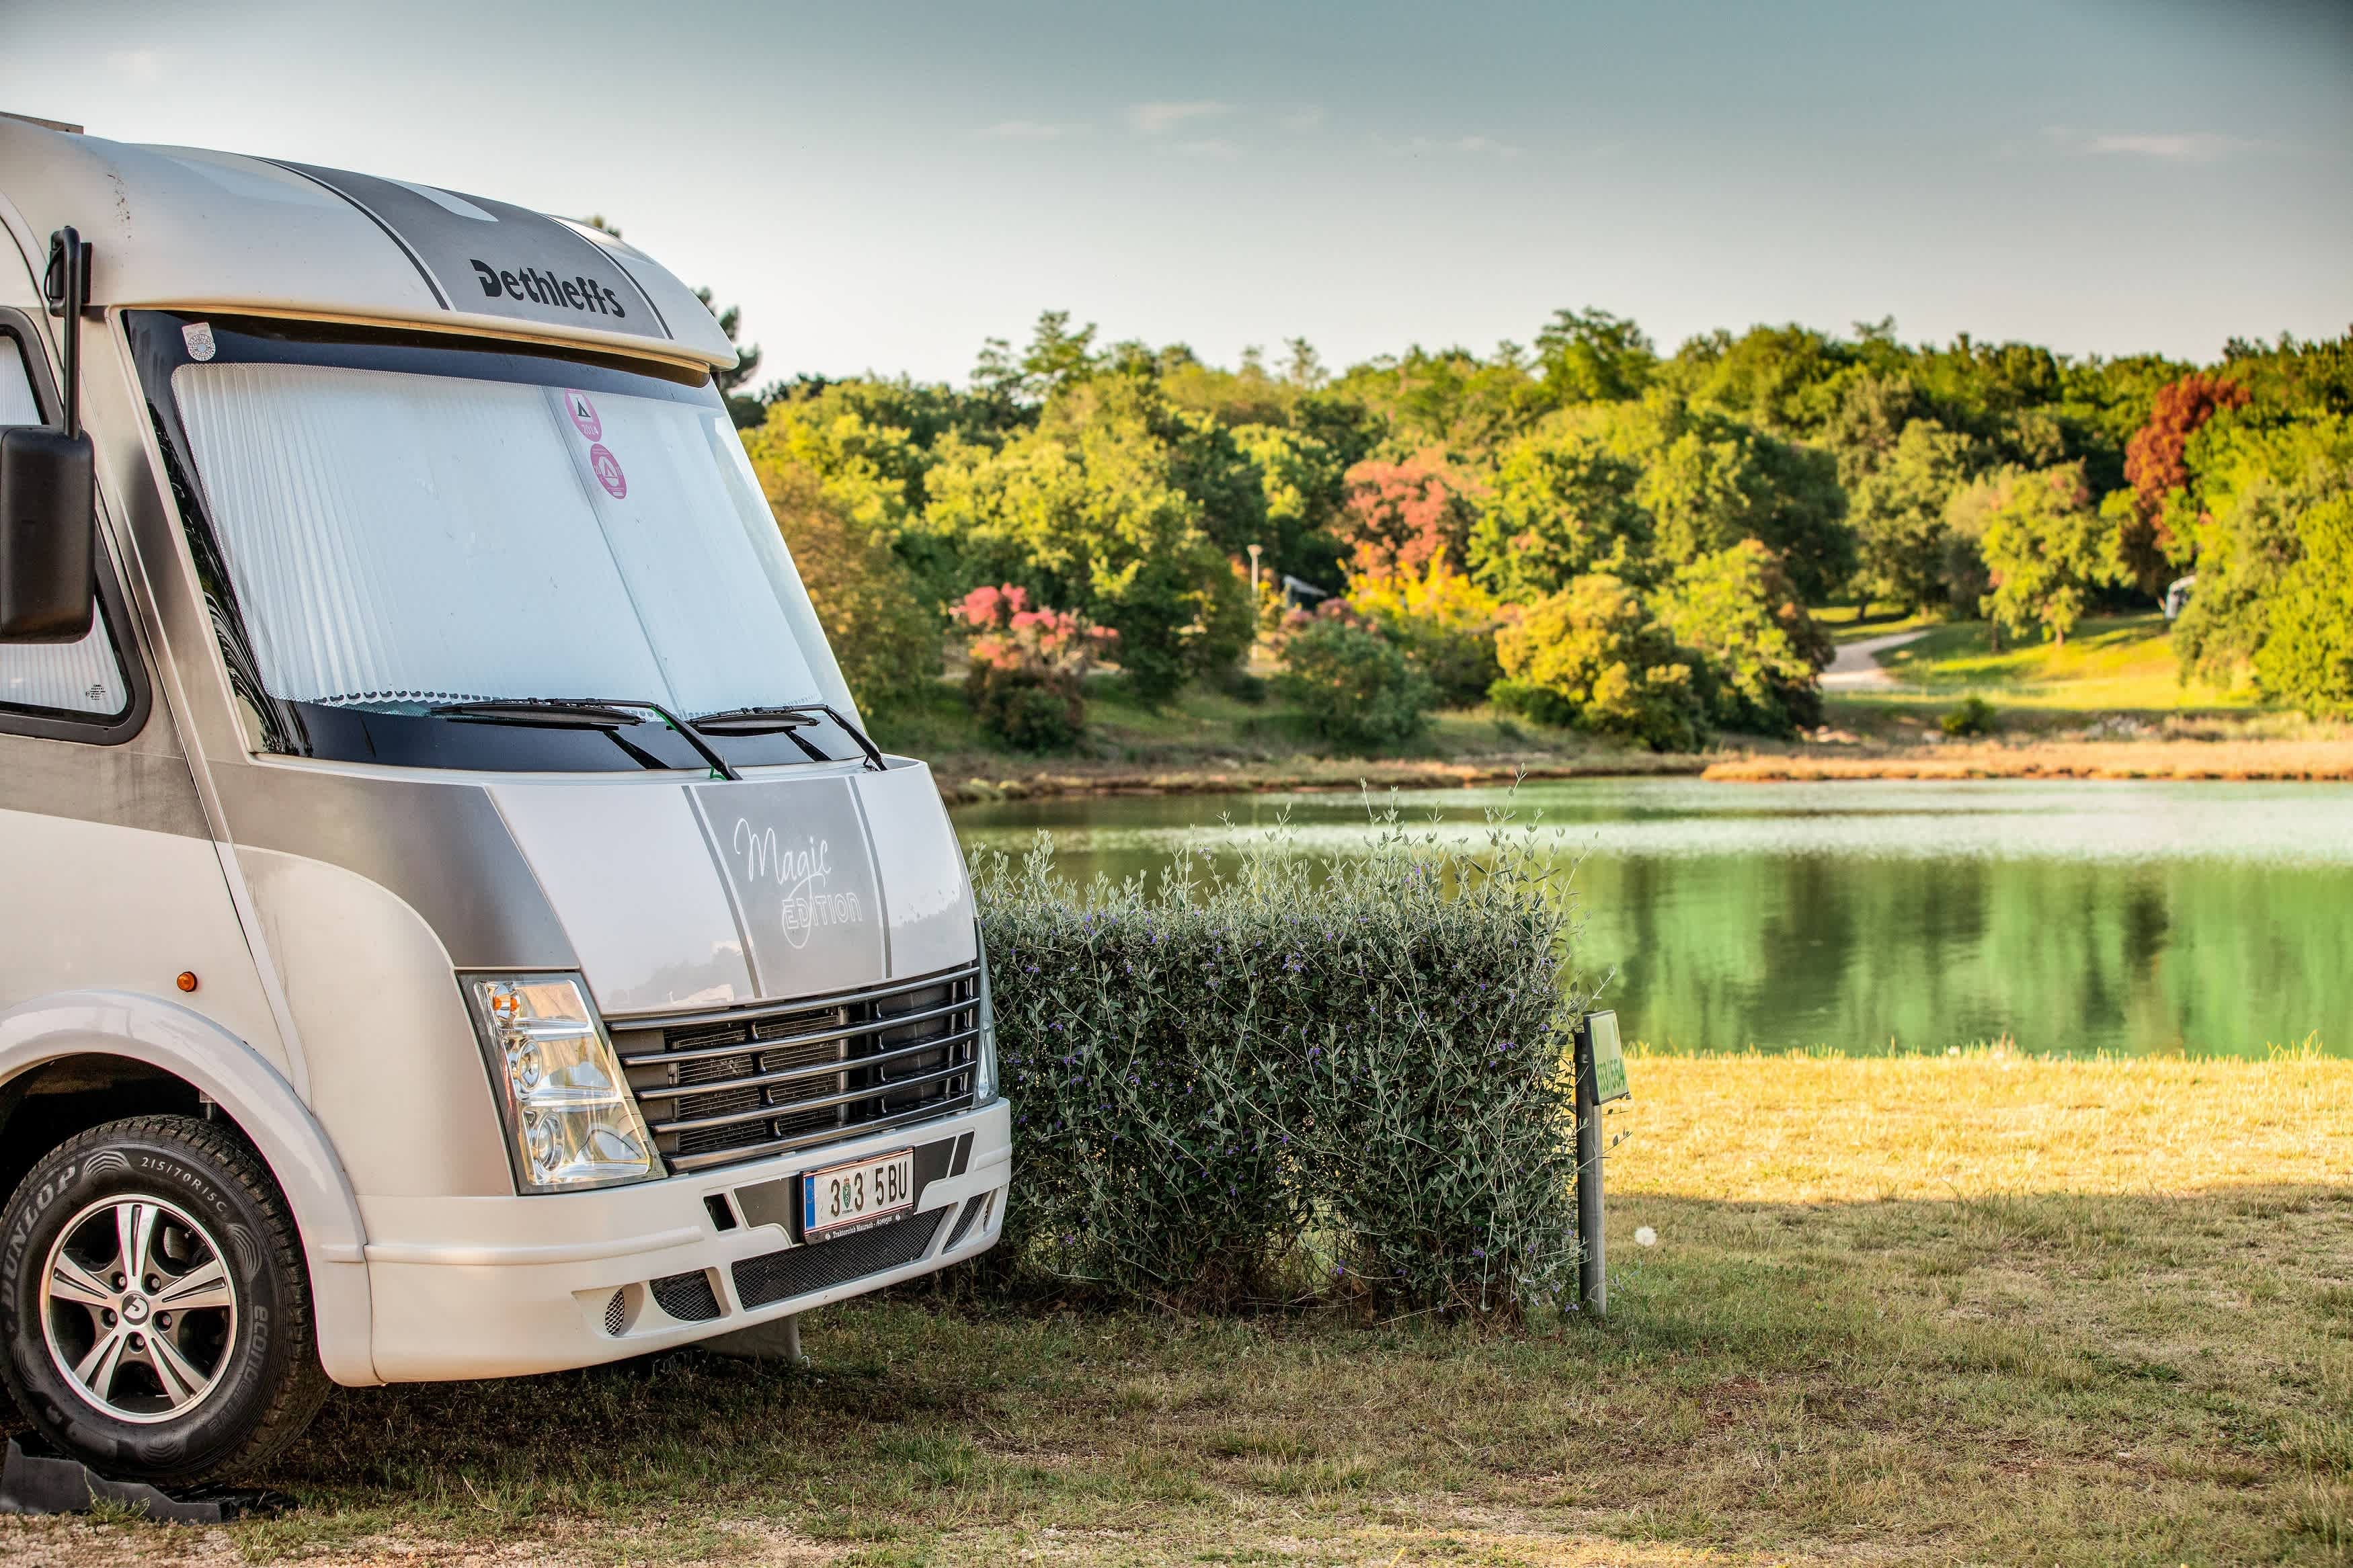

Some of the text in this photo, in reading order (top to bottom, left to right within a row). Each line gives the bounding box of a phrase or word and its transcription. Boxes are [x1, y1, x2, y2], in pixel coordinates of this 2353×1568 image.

[470, 258, 626, 318] Dethleffs
[733, 817, 832, 949] Magic
[1, 1165, 75, 1313] DUNLOP
